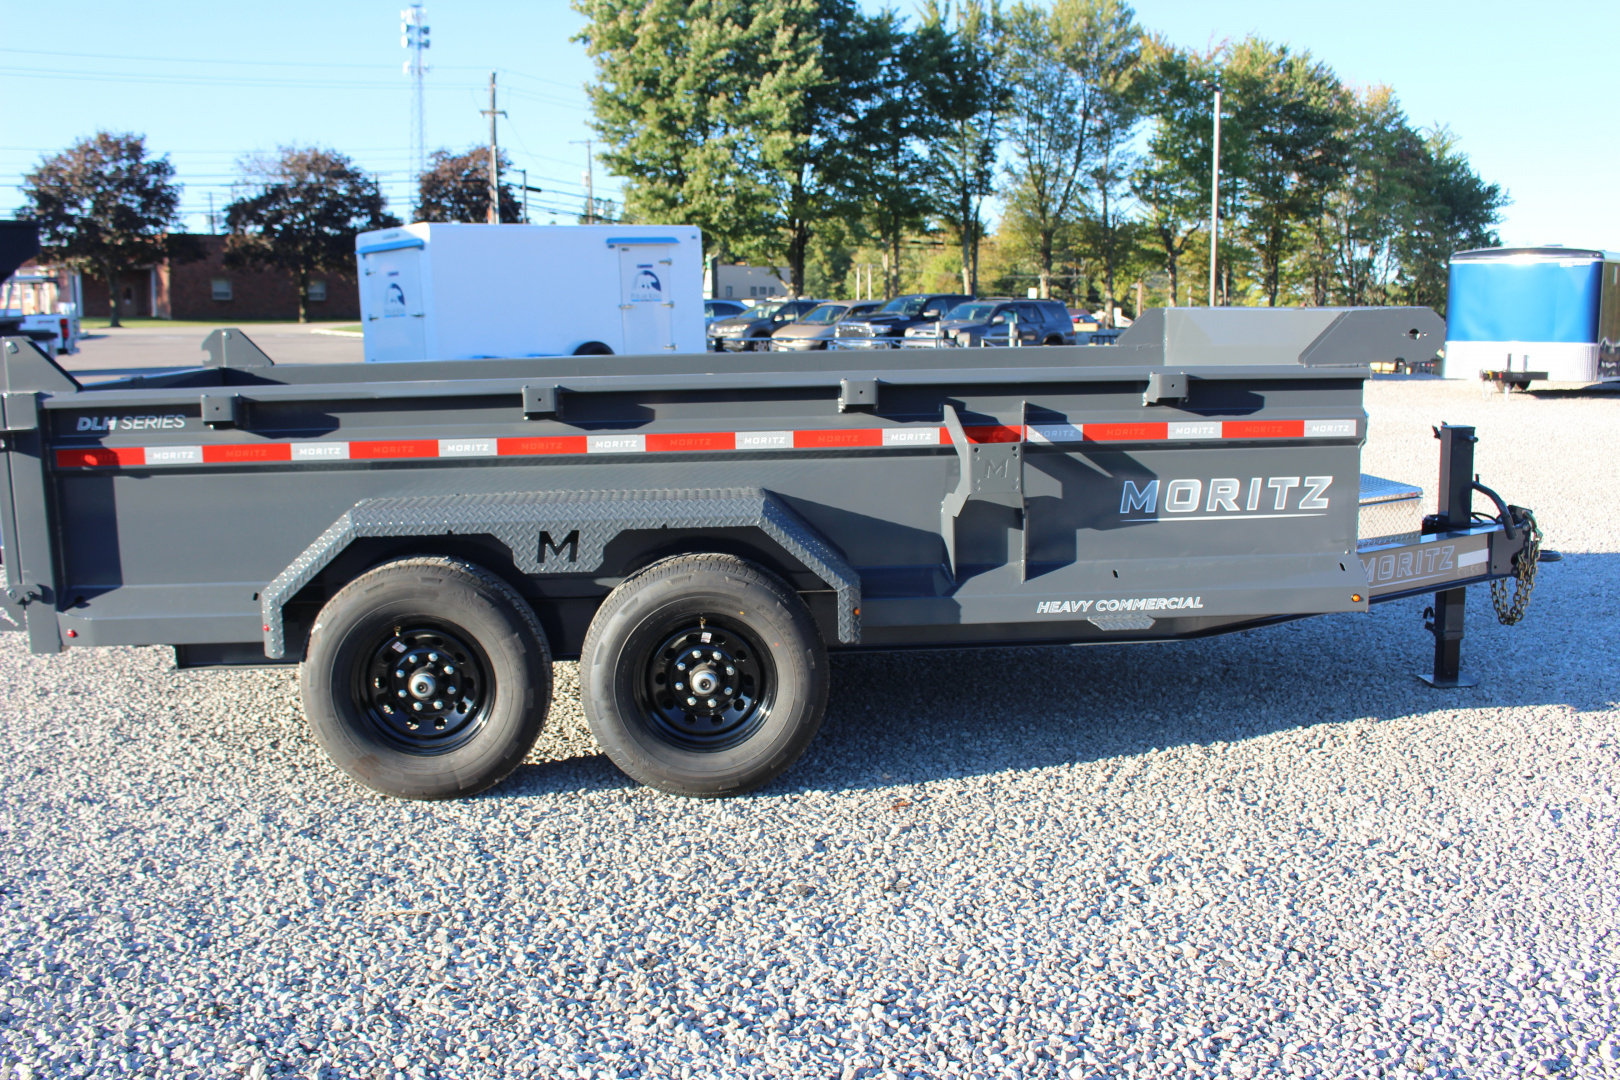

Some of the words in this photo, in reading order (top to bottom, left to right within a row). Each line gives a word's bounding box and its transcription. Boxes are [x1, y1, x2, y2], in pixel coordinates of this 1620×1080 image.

[77, 416, 117, 431] DLH
[120, 414, 186, 430] SERIES
[153, 451, 195, 460] MORITZ
[226, 449, 268, 458] MORITZ
[300, 447, 341, 457] MORITZ
[373, 445, 414, 455] MORITZ
[447, 443, 489, 452] MORITZ
[520, 442, 563, 451] MORITZ
[595, 440, 638, 449] MORITZ
[669, 438, 712, 447] MORITZ
[744, 436, 786, 445] MORITZ
[817, 434, 859, 443] MORITZ
[891, 432, 932, 442] MORITZ
[1035, 430, 1076, 438] MORITZ
[1106, 428, 1146, 437] MORITZ
[1175, 426, 1215, 435] MORITZ
[1312, 424, 1350, 433] MORITZ
[1120, 475, 1333, 514] MORITZ
[536, 530, 580, 564] M
[1360, 545, 1455, 583] MORITZ
[1036, 600, 1094, 614] HEAVY
[1095, 596, 1204, 612] COMMERCIAL
